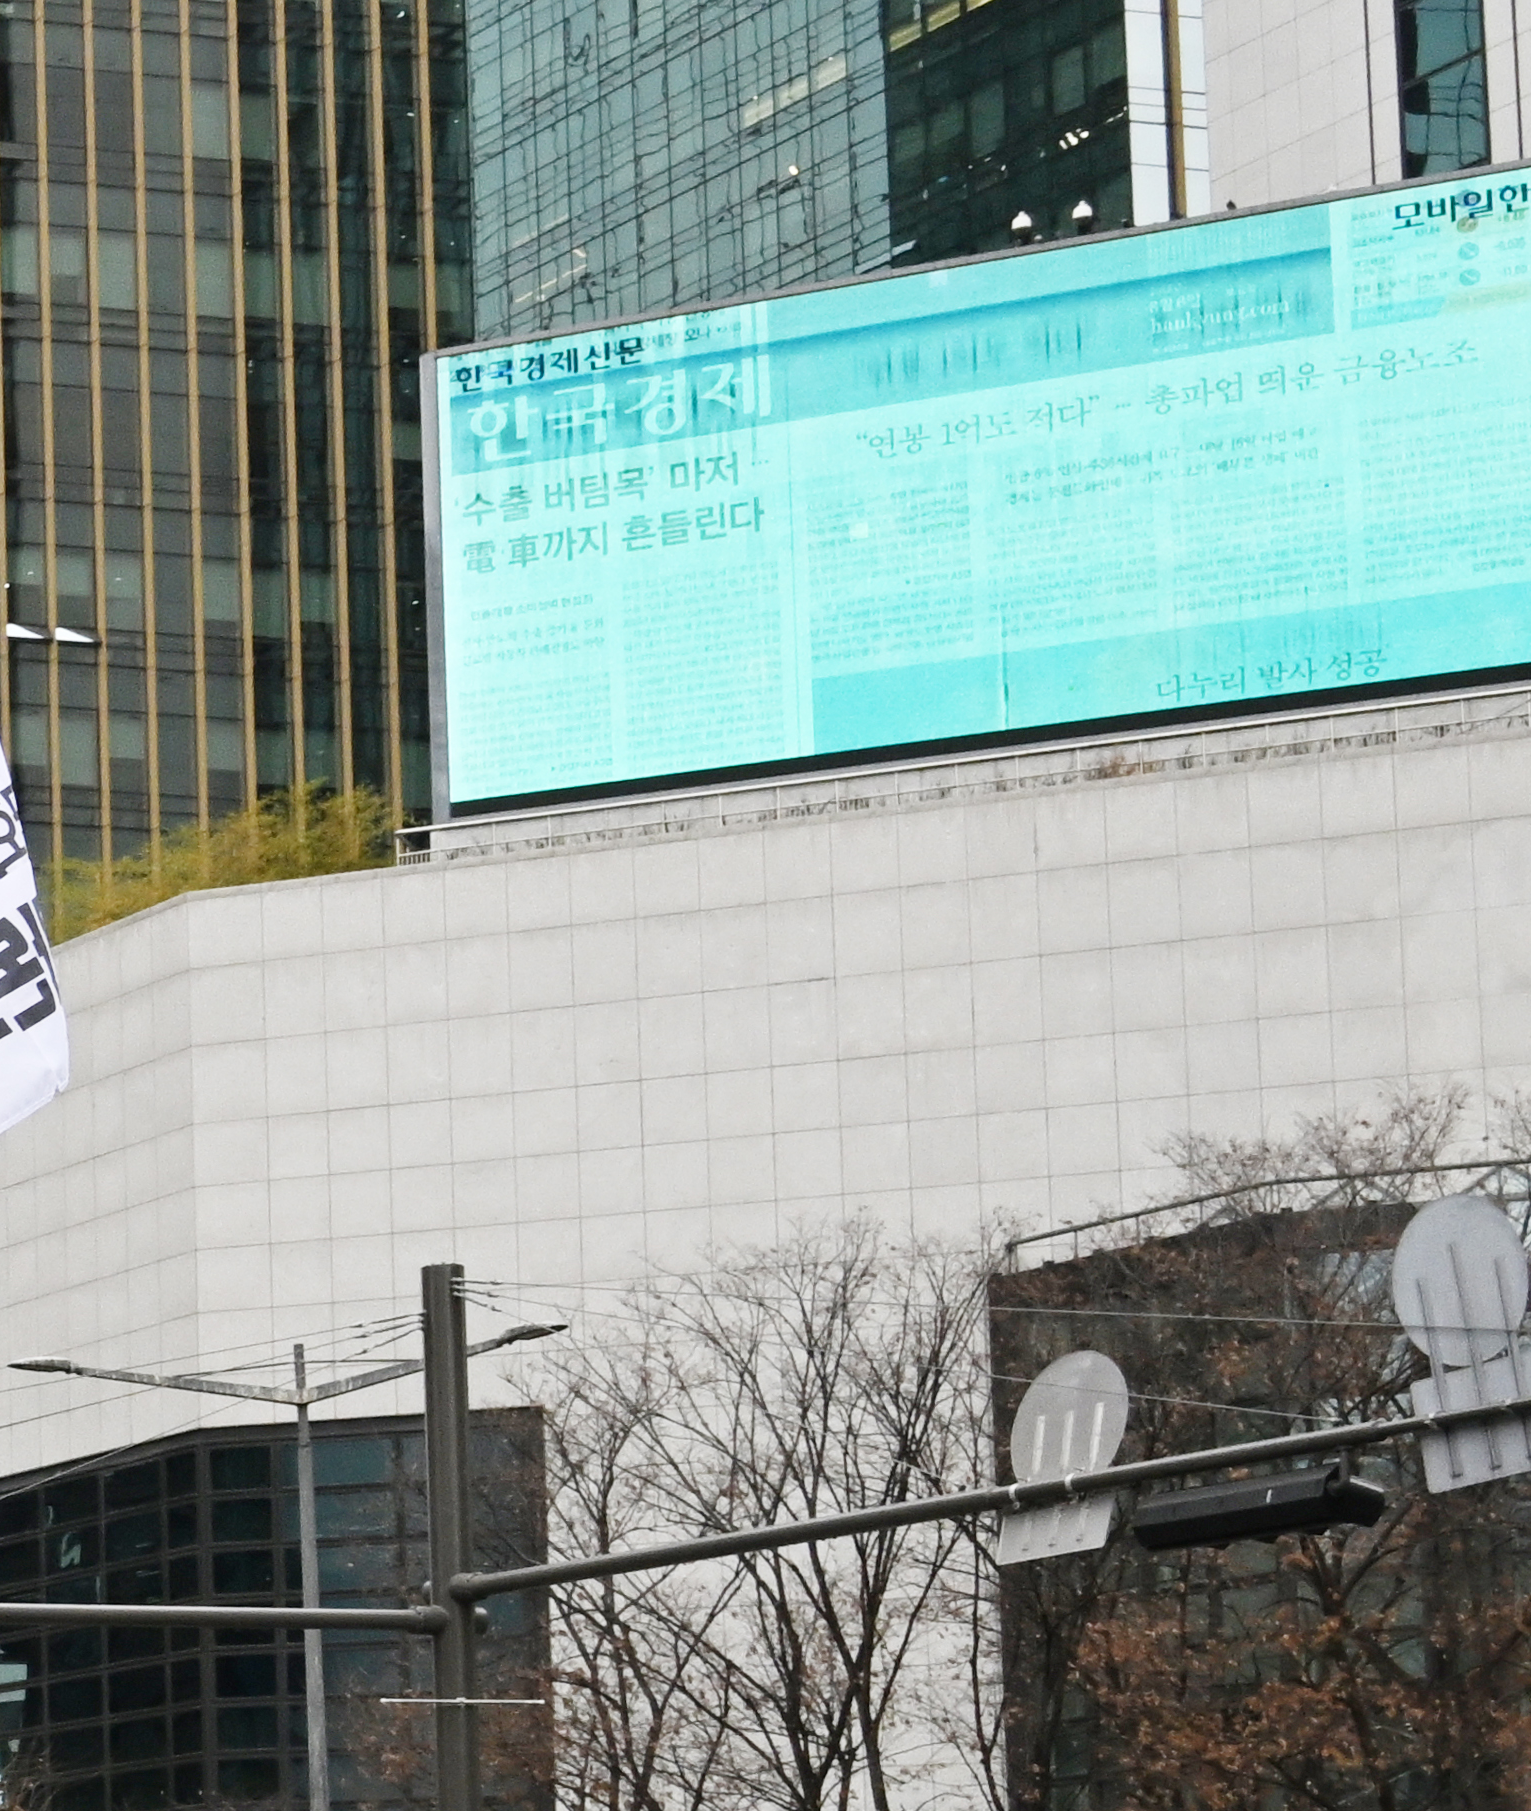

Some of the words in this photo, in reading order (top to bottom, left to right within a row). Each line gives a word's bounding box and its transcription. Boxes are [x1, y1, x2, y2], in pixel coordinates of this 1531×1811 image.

[455, 337, 644, 393] 한국경제신문
[1145, 373, 1246, 416] 총파업
[1333, 338, 1481, 386] 금융노조
[468, 354, 773, 464] 한국경제
[670, 450, 741, 494] 마저
[622, 497, 766, 553] 흔들린다
[1156, 667, 1246, 703] 다누리
[1325, 647, 1387, 683] 성공
